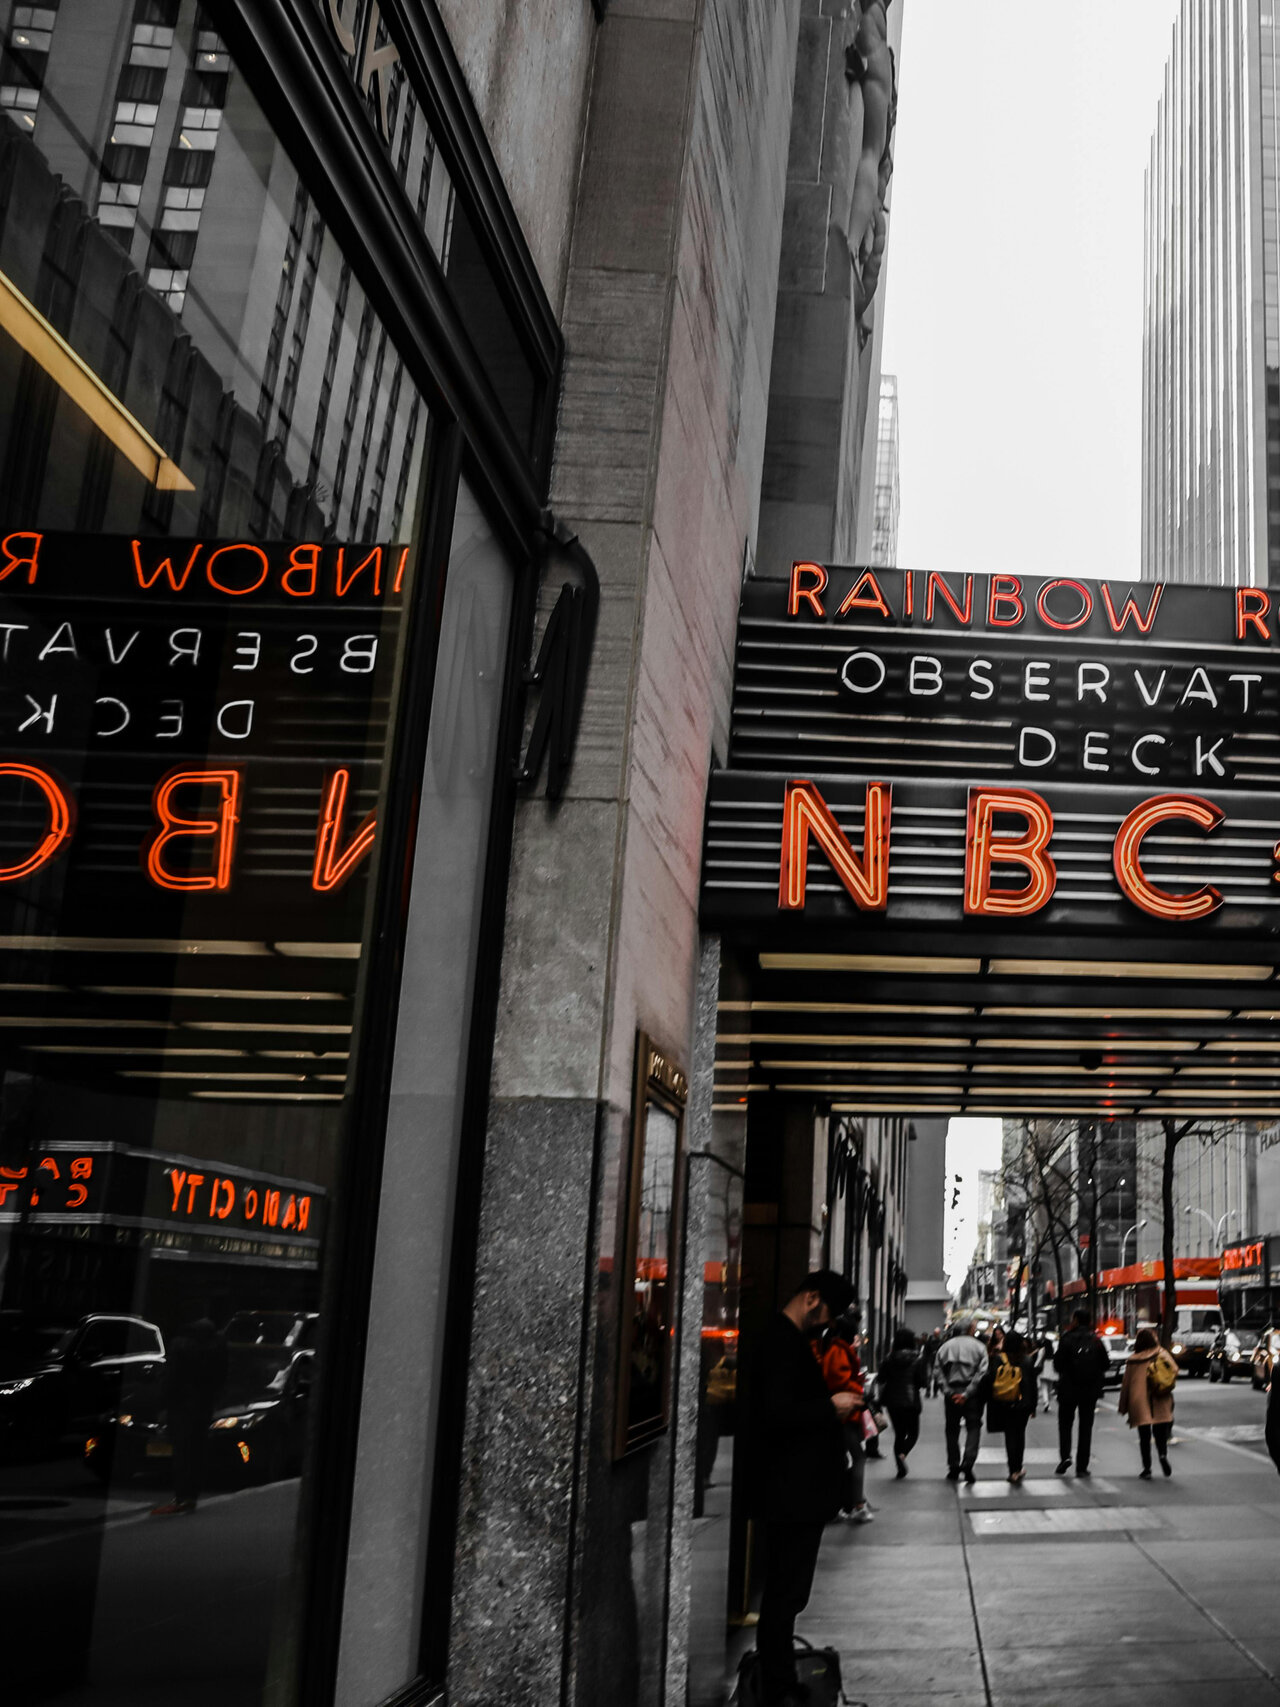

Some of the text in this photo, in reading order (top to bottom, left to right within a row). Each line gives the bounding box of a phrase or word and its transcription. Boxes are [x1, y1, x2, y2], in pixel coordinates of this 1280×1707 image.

[788, 561, 1164, 635] RAINBOW
[1018, 726, 1226, 778] DECK
[777, 779, 1228, 922] NBC
